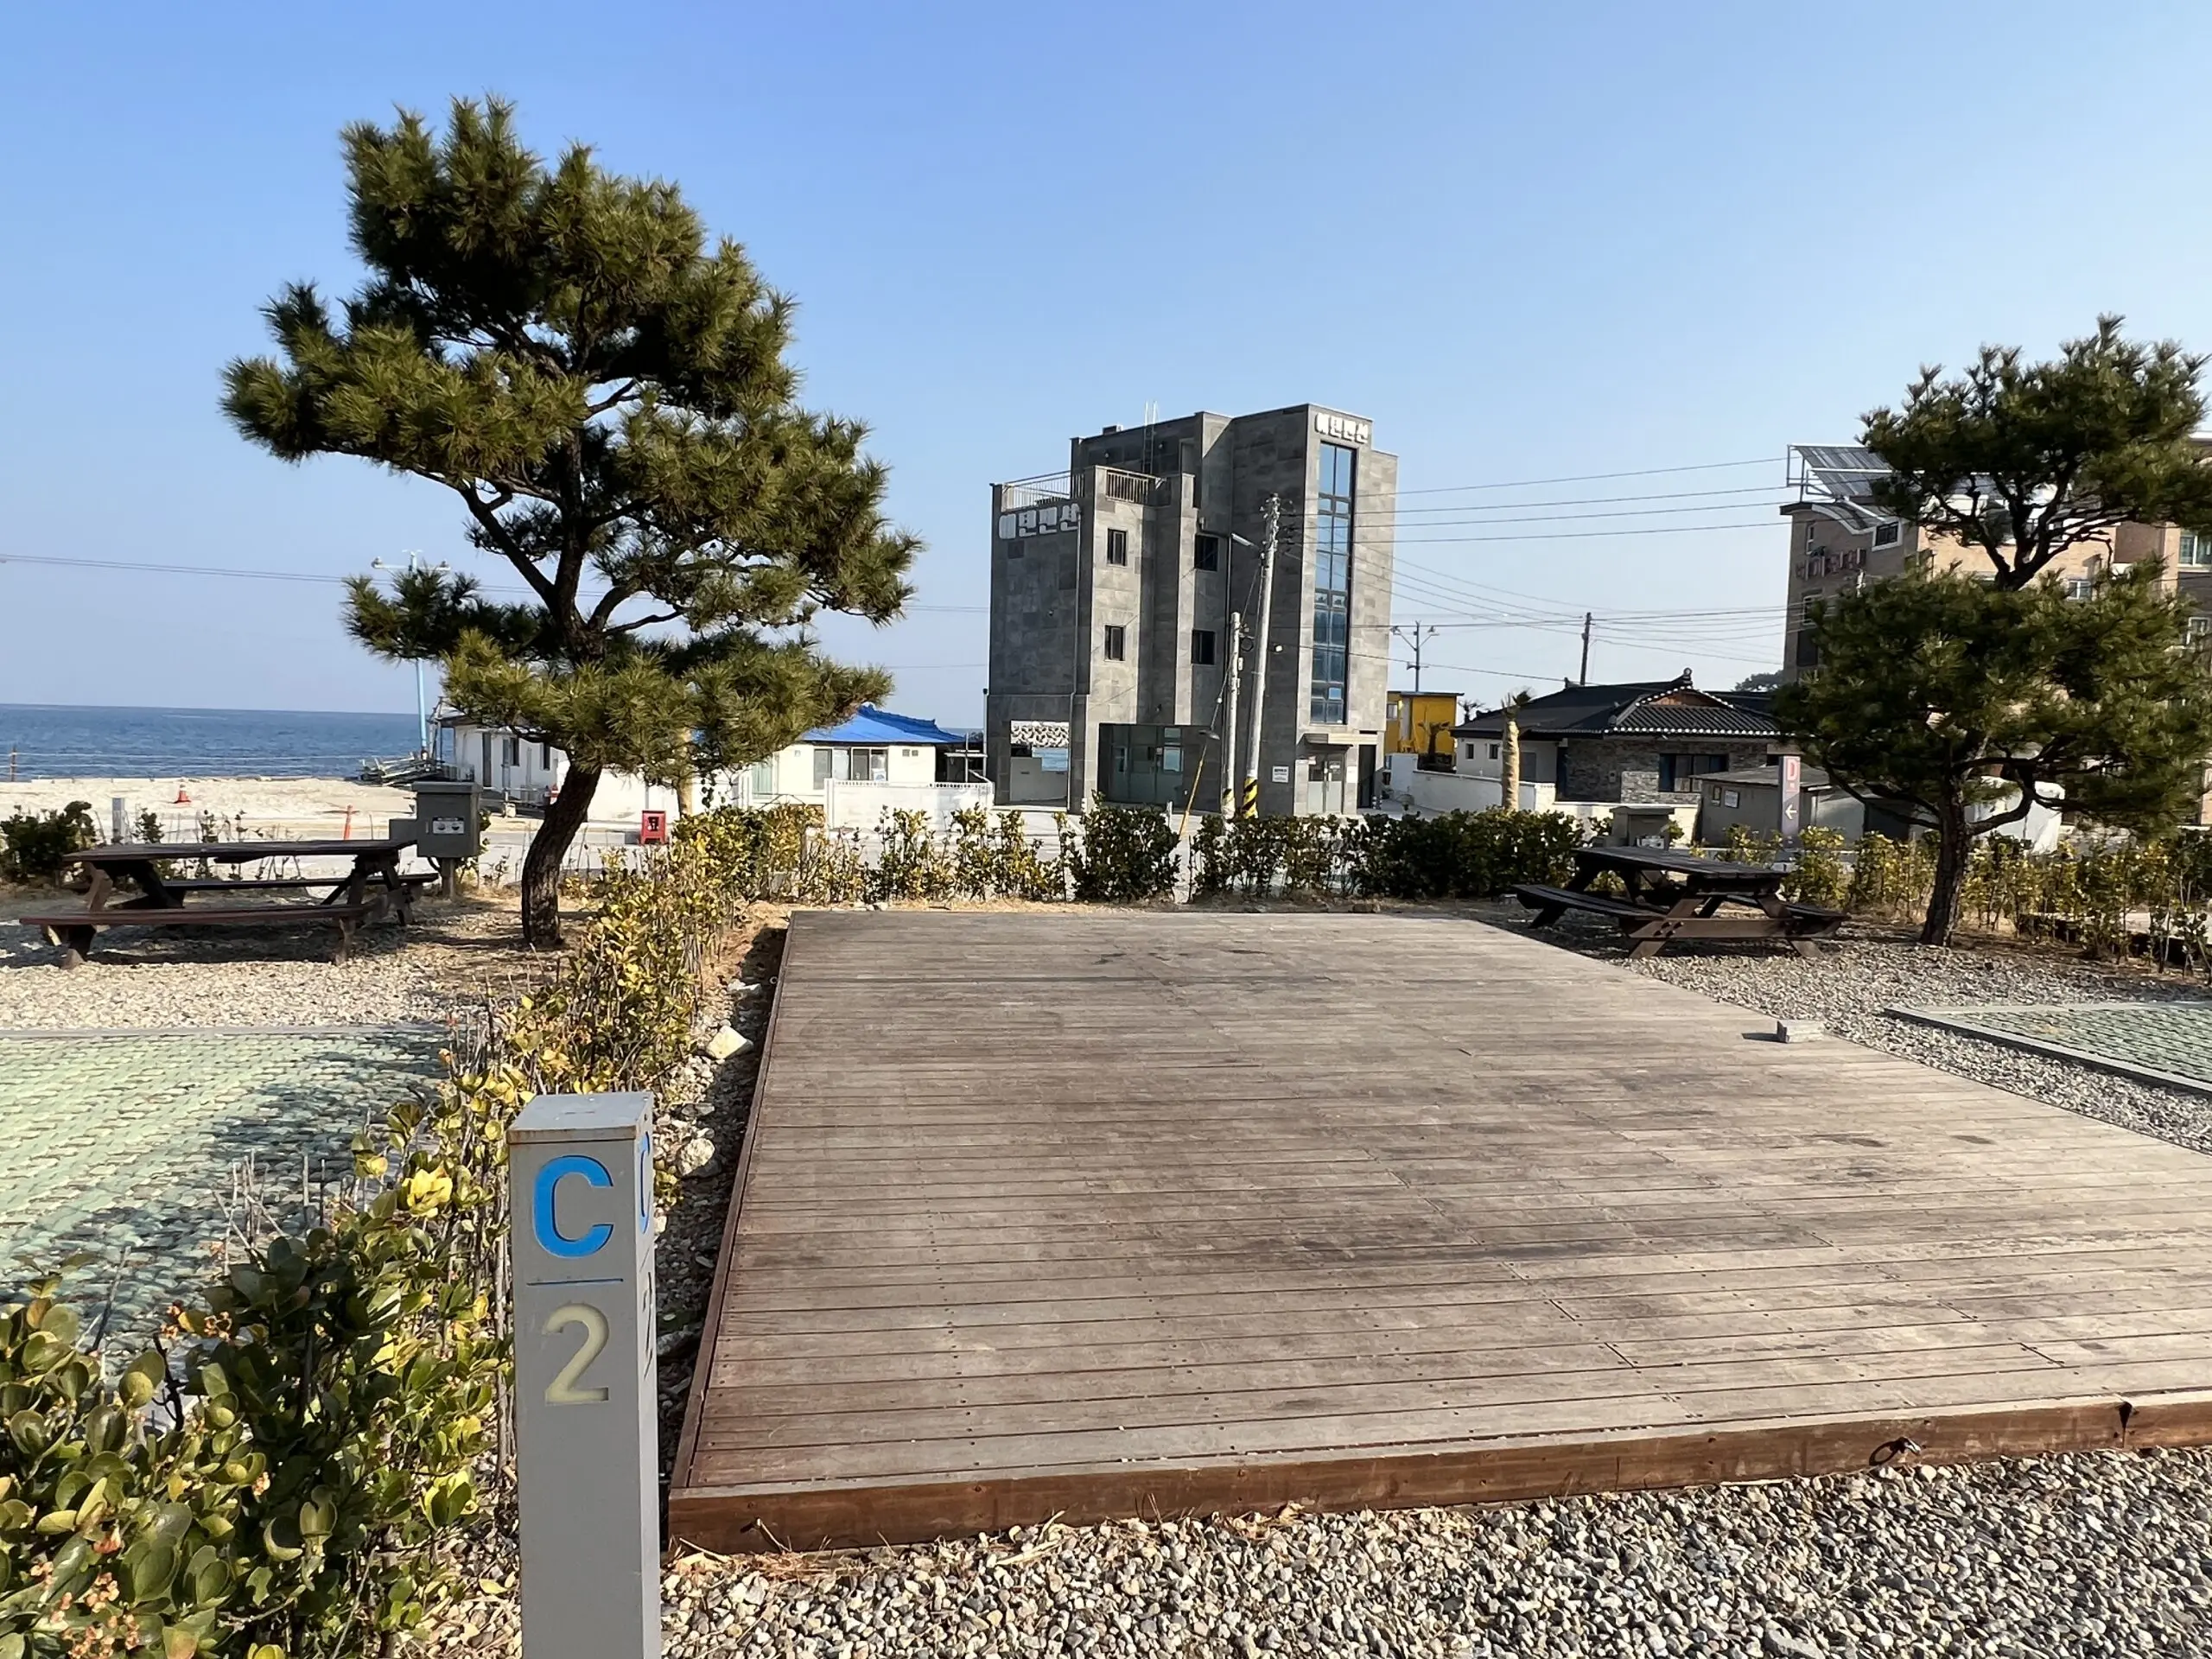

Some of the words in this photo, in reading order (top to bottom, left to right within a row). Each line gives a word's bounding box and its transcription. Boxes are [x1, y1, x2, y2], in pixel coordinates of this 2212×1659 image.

[1787, 760, 1798, 781] D
[532, 1154, 613, 1259] C
[541, 1302, 609, 1406] 2
